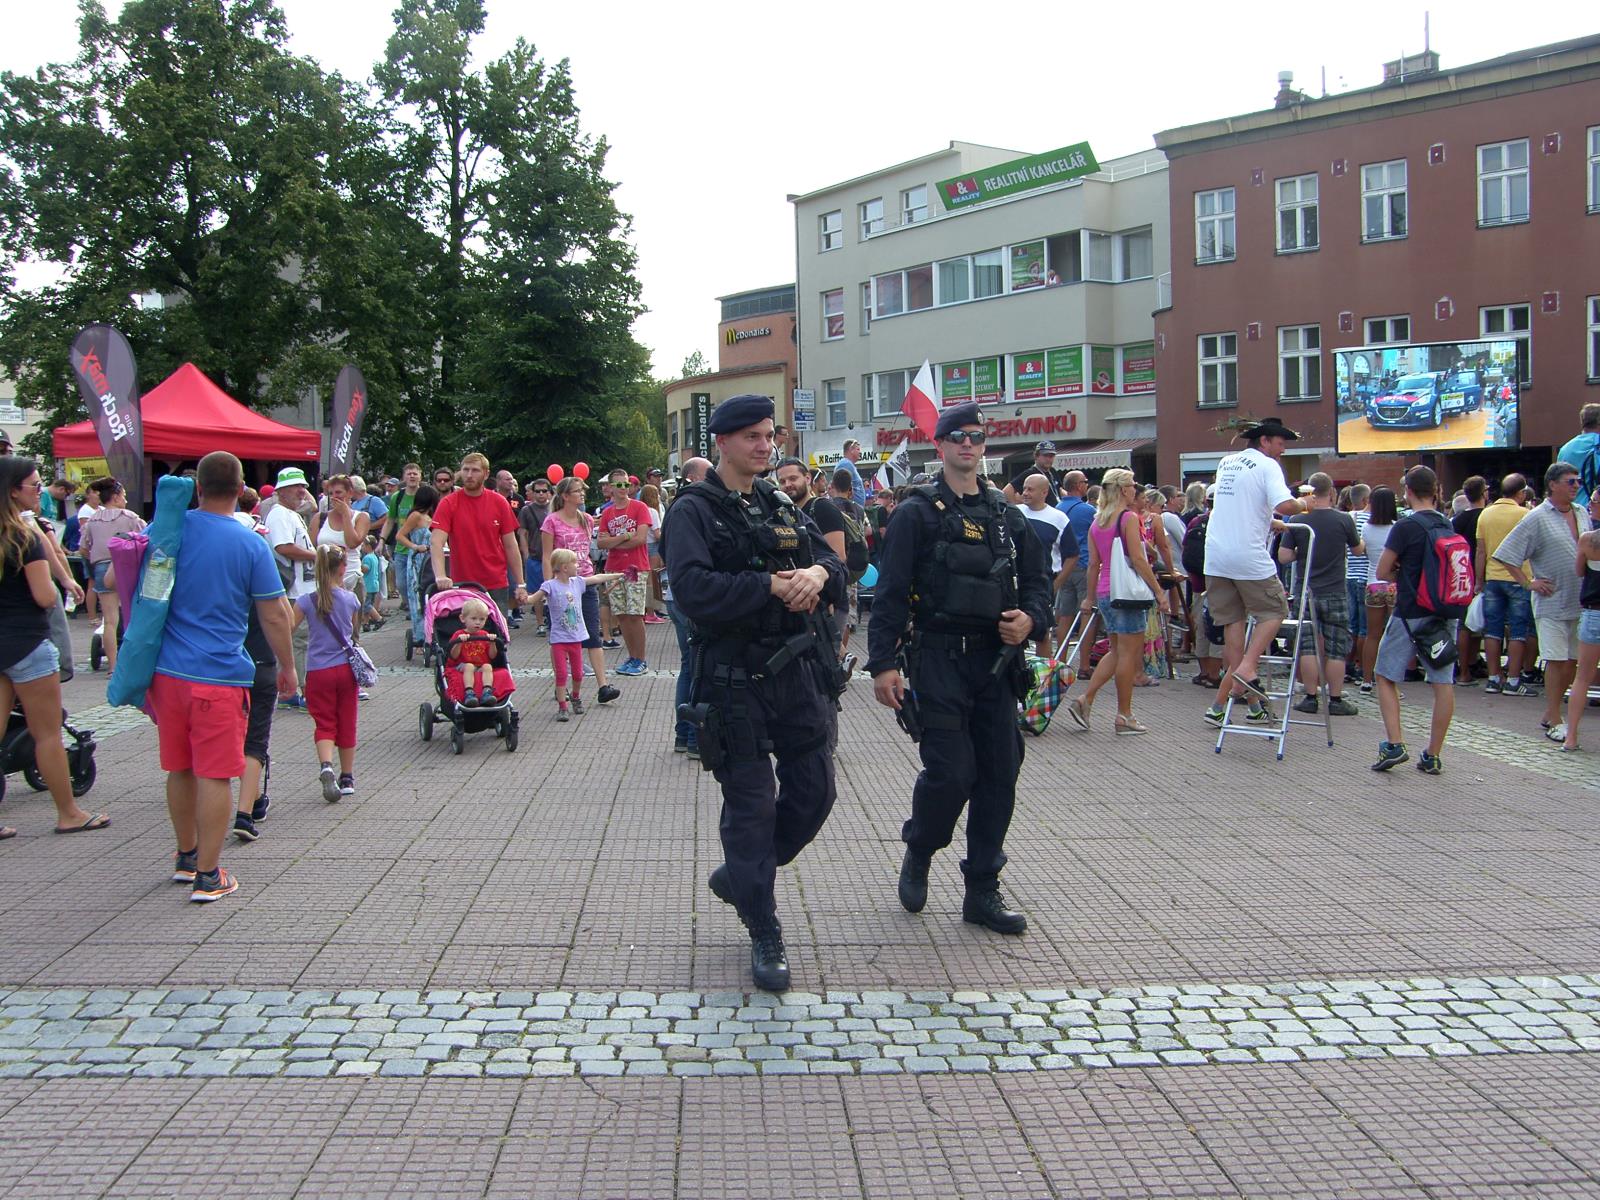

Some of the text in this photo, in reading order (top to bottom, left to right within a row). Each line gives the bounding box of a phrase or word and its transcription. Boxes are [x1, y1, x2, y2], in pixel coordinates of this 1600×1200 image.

[983, 151, 1087, 191] REALITNÍ KANCELÁŘ
[952, 191, 980, 204] REALITY
[725, 328, 770, 346] McDonald's
[699, 396, 708, 458] cDonald's
[985, 410, 1077, 437] ČERVINKŮ
[1057, 455, 1109, 468] ZMRZLINA
